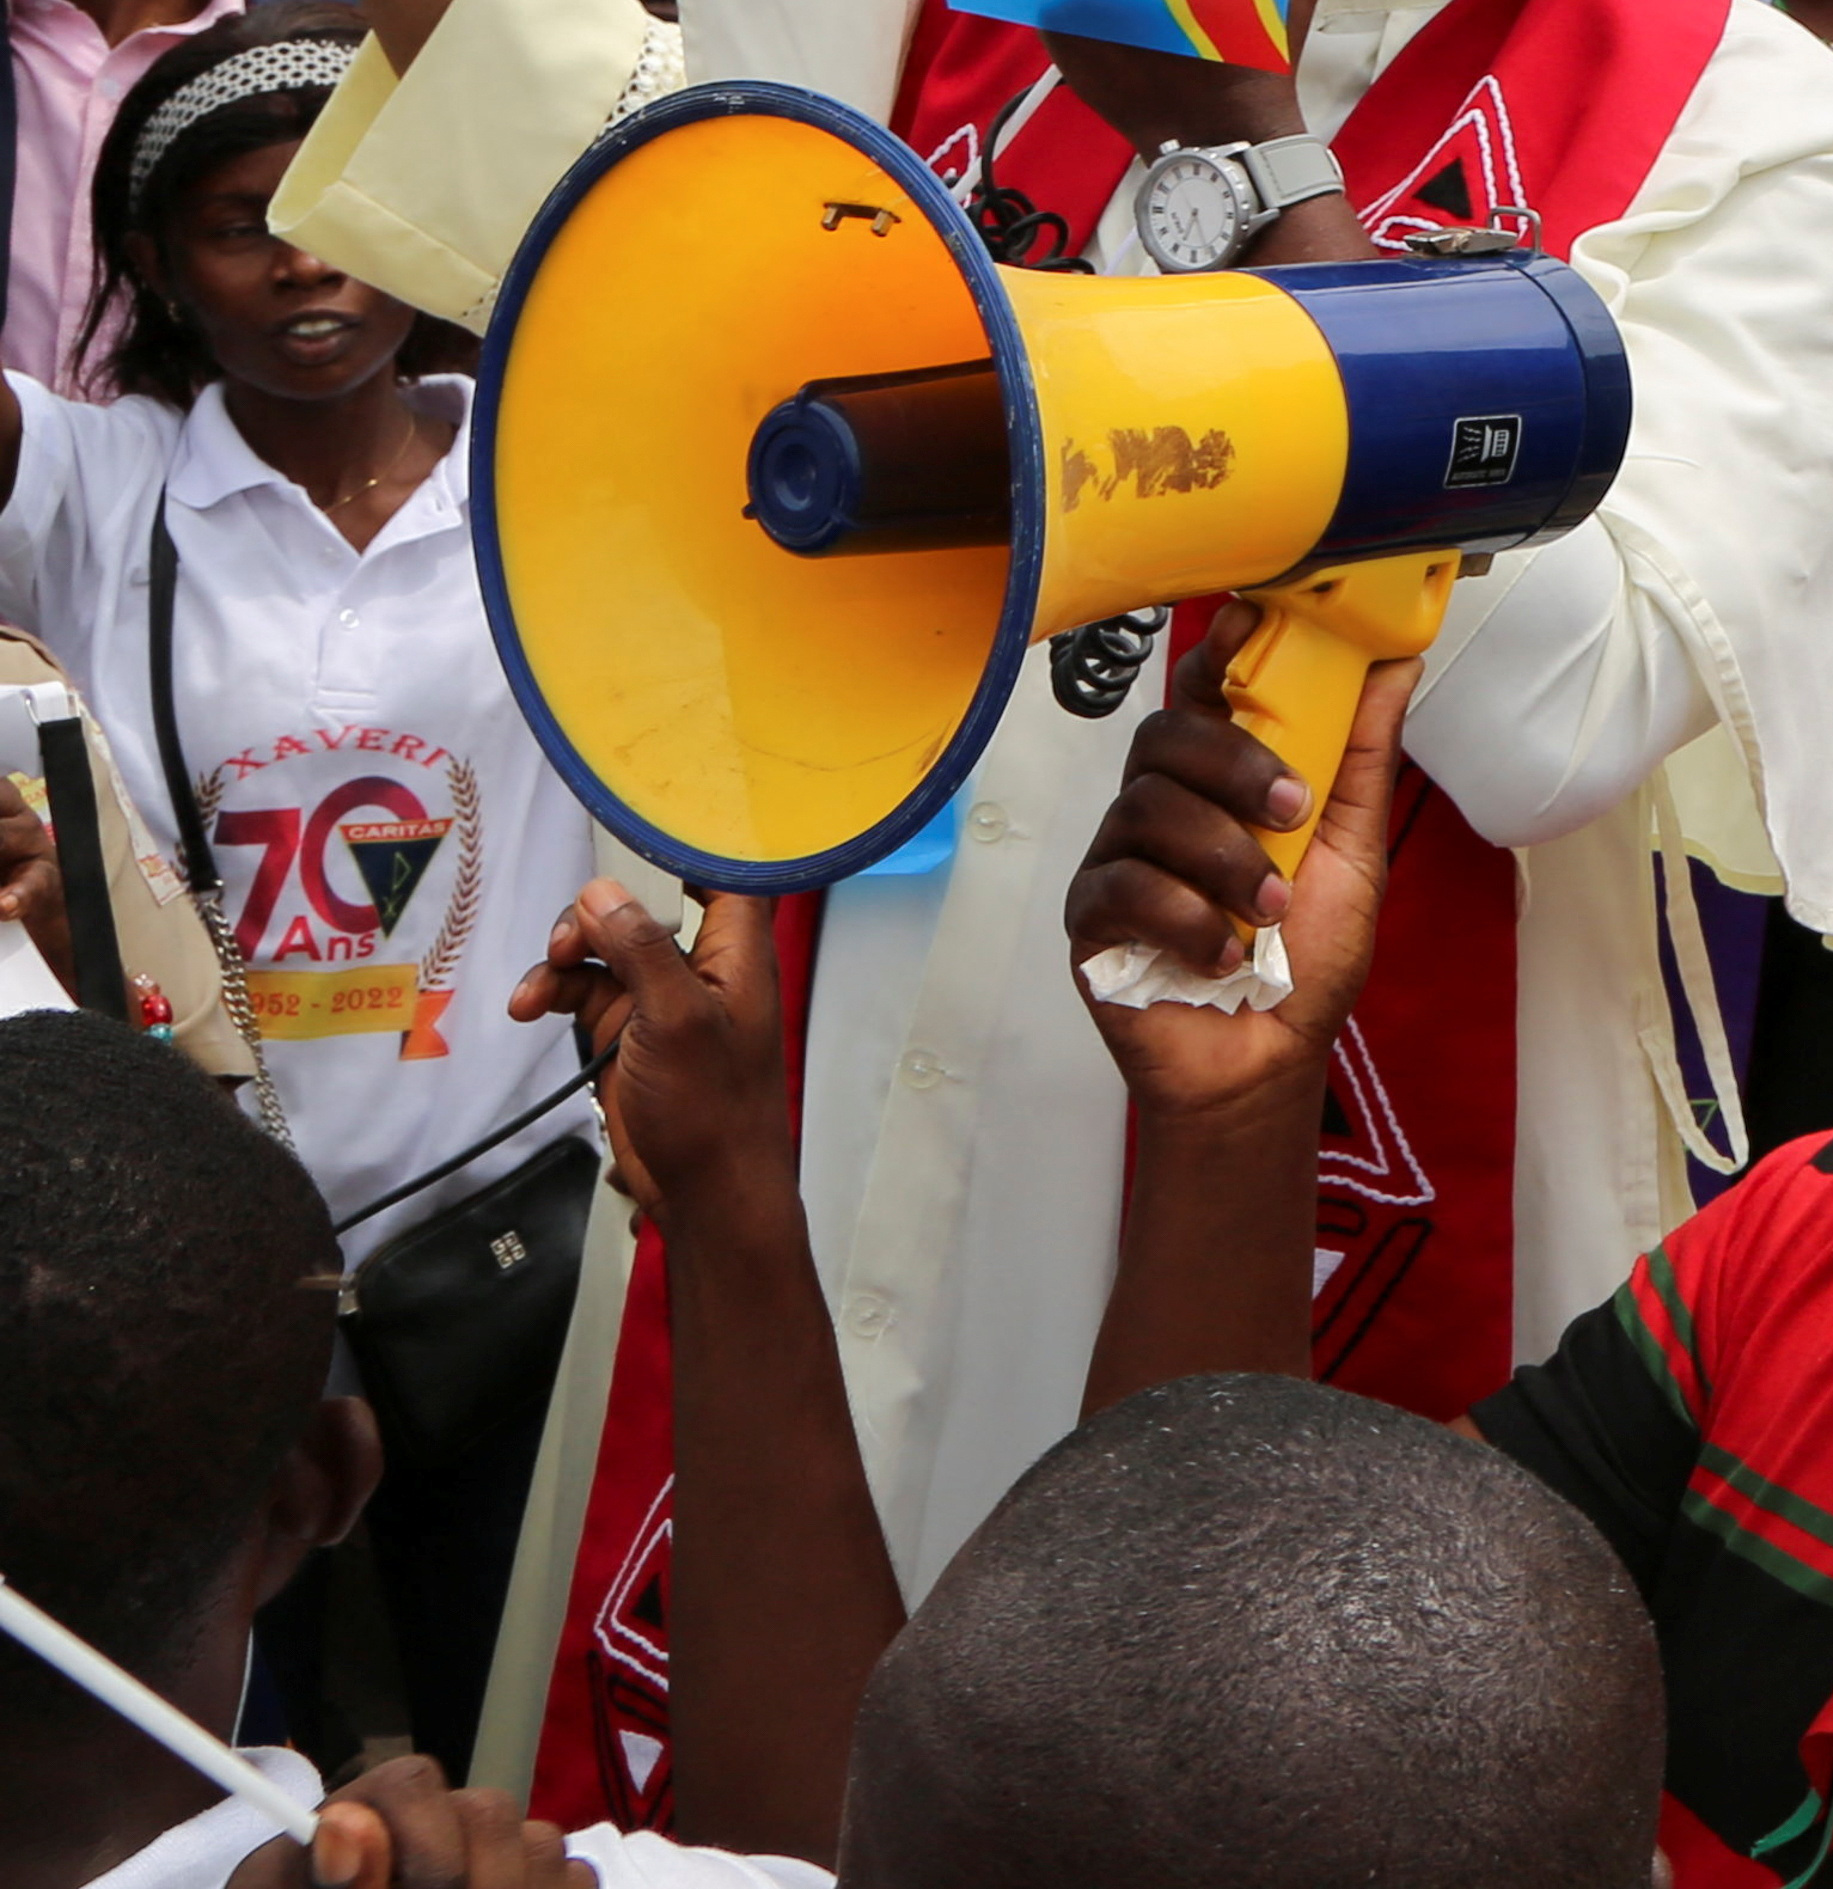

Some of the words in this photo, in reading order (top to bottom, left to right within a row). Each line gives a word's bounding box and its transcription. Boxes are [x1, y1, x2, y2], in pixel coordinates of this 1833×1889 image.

[225, 725, 450, 781] XAVERI
[347, 820, 447, 841] CARITAS
[273, 916, 377, 964] Ans
[251, 988, 301, 1017] 952
[332, 985, 406, 1011] 2022
